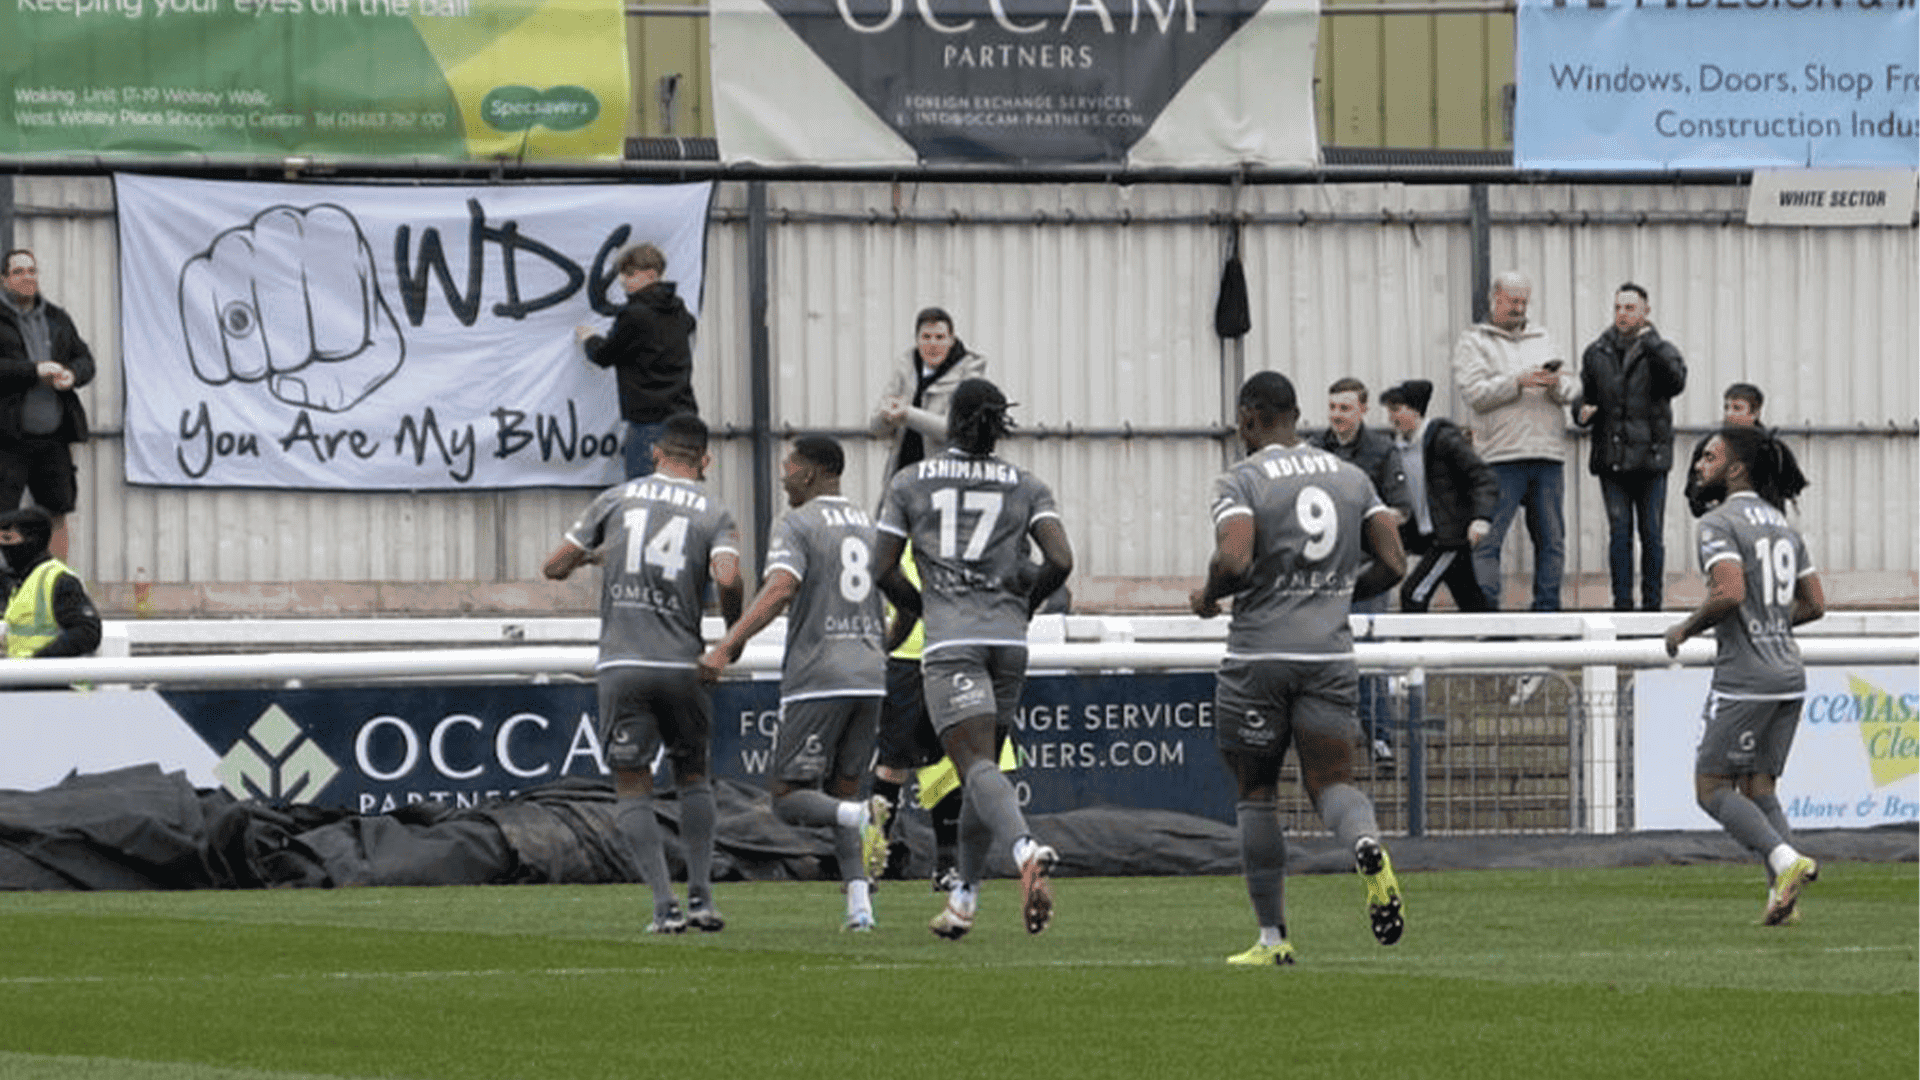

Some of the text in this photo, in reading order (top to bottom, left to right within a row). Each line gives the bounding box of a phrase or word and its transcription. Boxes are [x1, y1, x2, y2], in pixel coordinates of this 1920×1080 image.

[943, 45, 1093, 68] PARTNERS
[1549, 63, 1691, 94] Windows,
[1700, 63, 1797, 94] Doors,
[1804, 63, 1873, 100] Shop
[490, 99, 588, 117] Specsavers
[973, 96, 1053, 109] EXCHANGE
[1059, 96, 1133, 109] SERVICES
[1655, 109, 1842, 138] Construction
[1778, 189, 1886, 207] WHITE SECTOR
[177, 400, 626, 482] You Are My BWoo
[918, 459, 1019, 484] TSHIMANGA
[624, 482, 706, 512] BALANTA
[931, 487, 1004, 561] 17
[1296, 485, 1338, 560] 9
[623, 507, 689, 580] 14
[840, 536, 872, 603] 8
[1755, 537, 1796, 606] 19
[1084, 701, 1214, 730] SERVICE
[1869, 726, 1918, 760] Cle
[1787, 795, 1848, 818] Above
[1856, 793, 1877, 817] &
